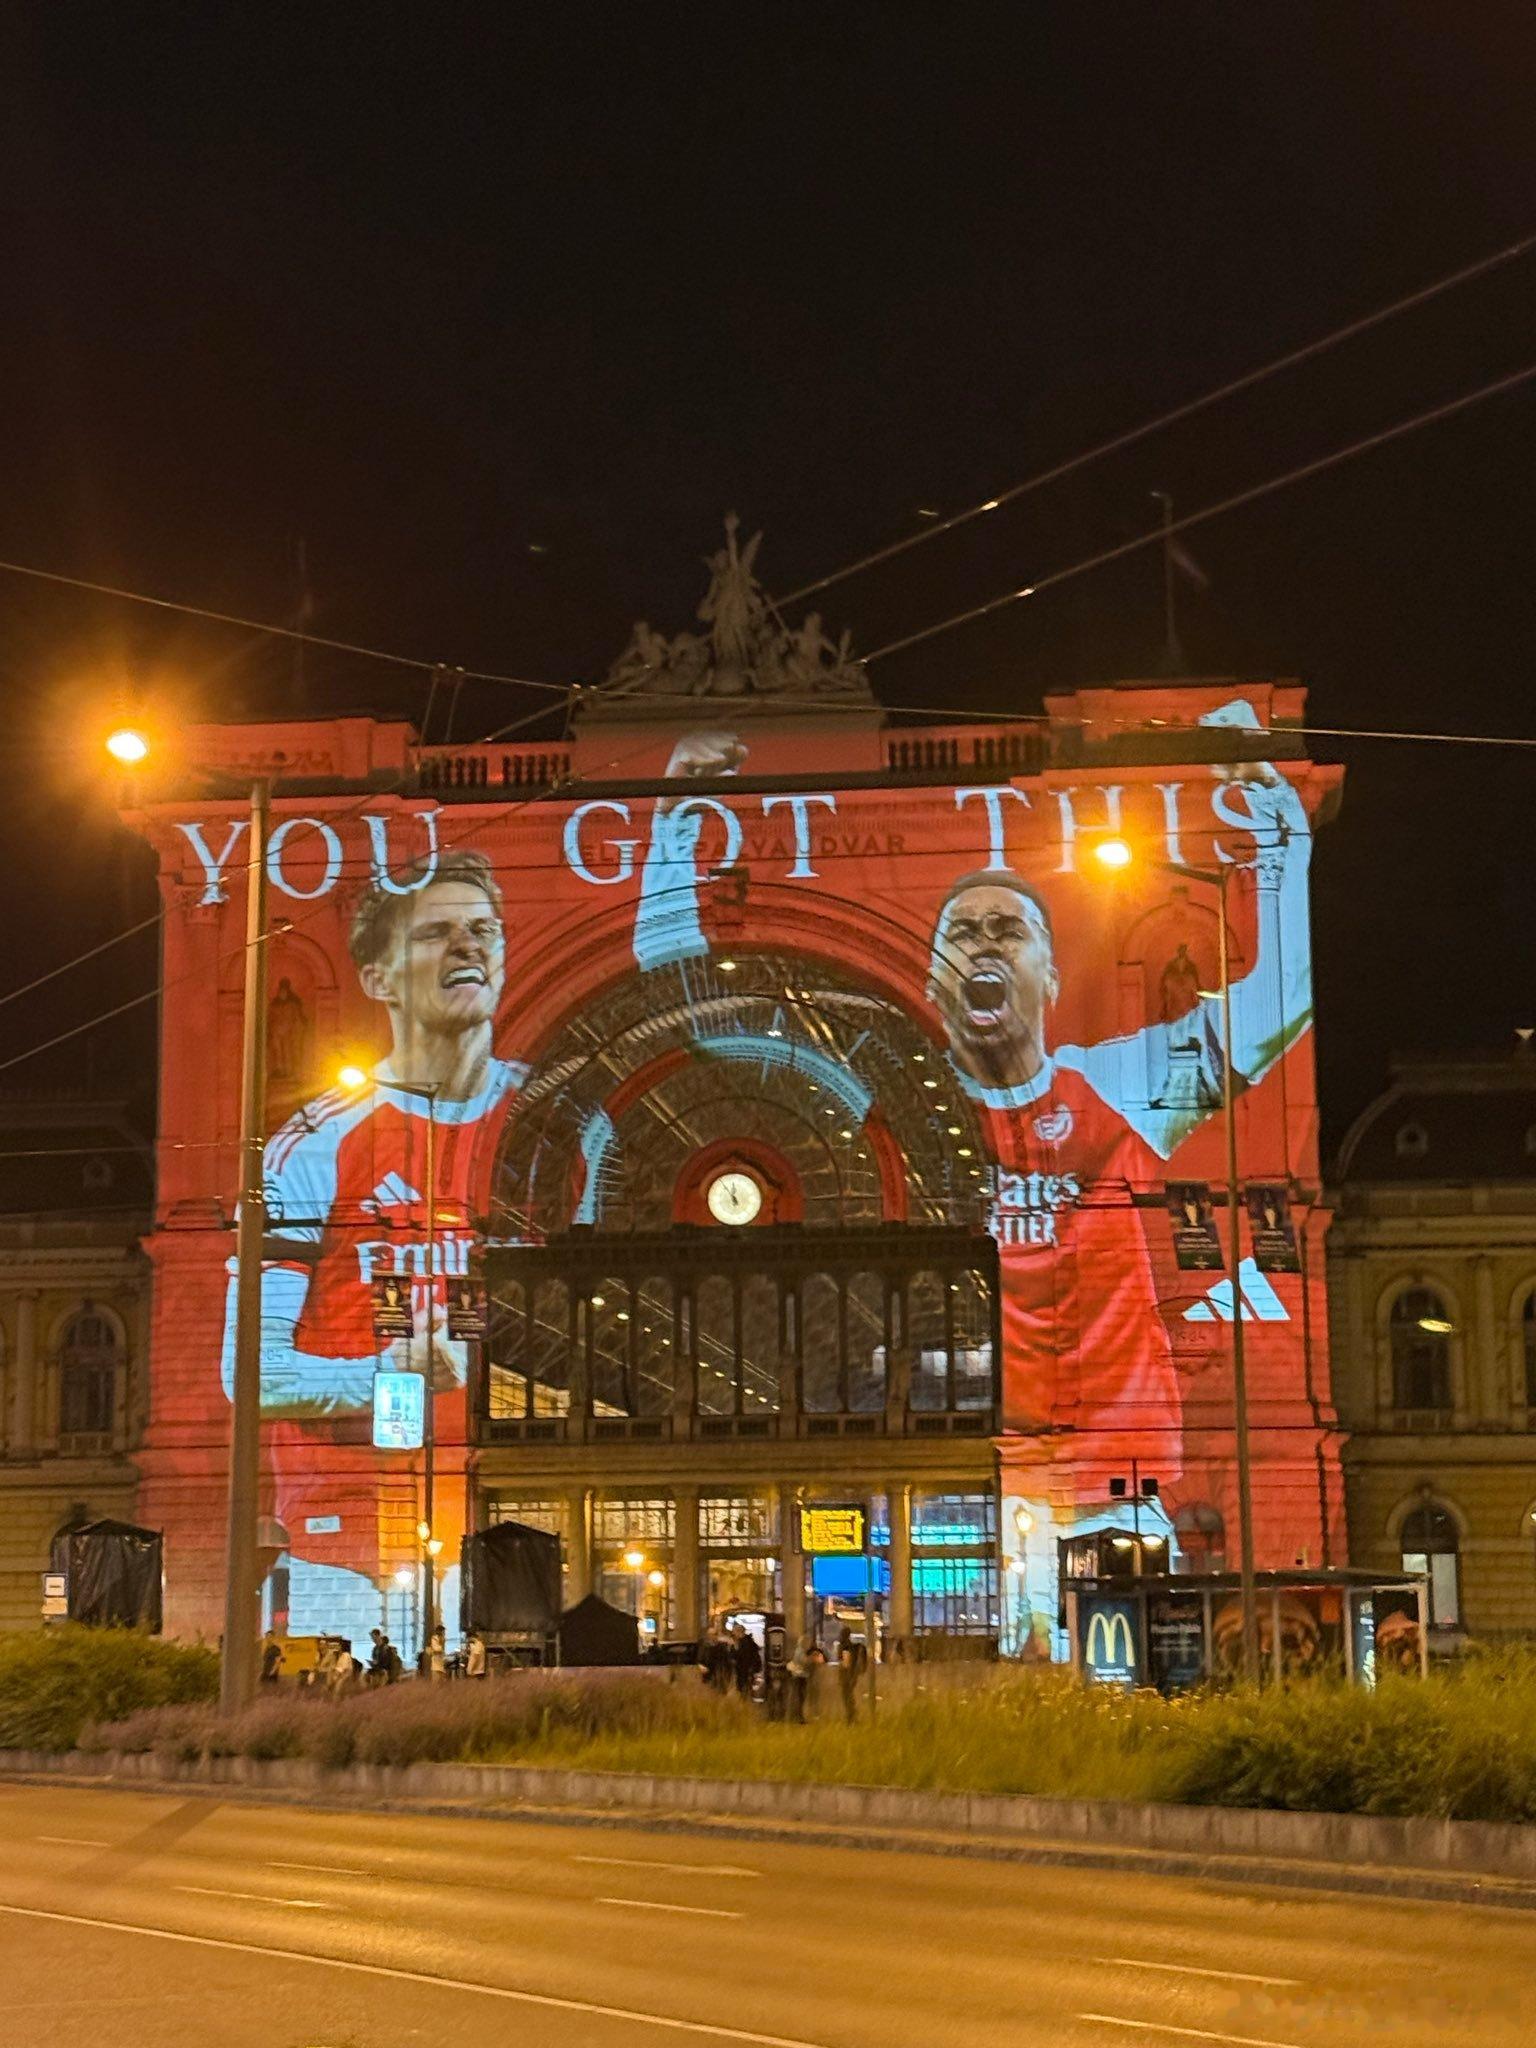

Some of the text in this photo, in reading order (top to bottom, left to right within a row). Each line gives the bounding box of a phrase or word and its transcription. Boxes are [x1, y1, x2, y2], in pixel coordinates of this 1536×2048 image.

[173, 780, 1266, 907] YOU GOT THIS
